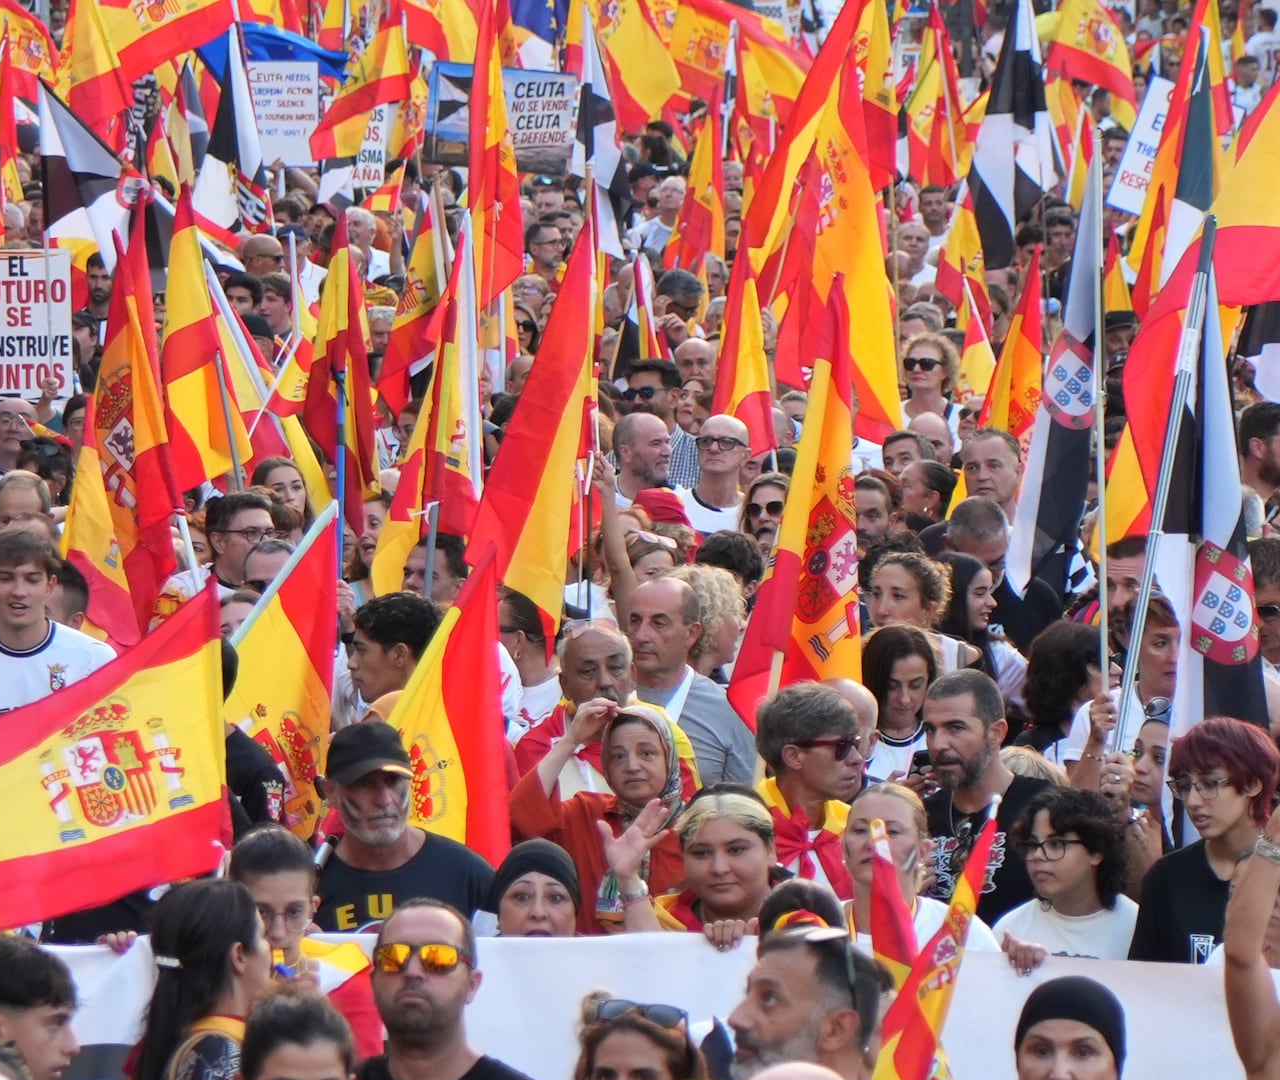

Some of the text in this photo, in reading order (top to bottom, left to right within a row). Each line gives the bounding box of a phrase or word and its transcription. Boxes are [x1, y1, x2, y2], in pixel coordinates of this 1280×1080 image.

[514, 81, 565, 98] CEUTA
[511, 99, 569, 113] NO SE VENDE
[516, 114, 560, 130] CEUTA
[519, 131, 568, 144] DEFIENDE
[8, 256, 29, 276] EL
[6, 307, 32, 327] SE
